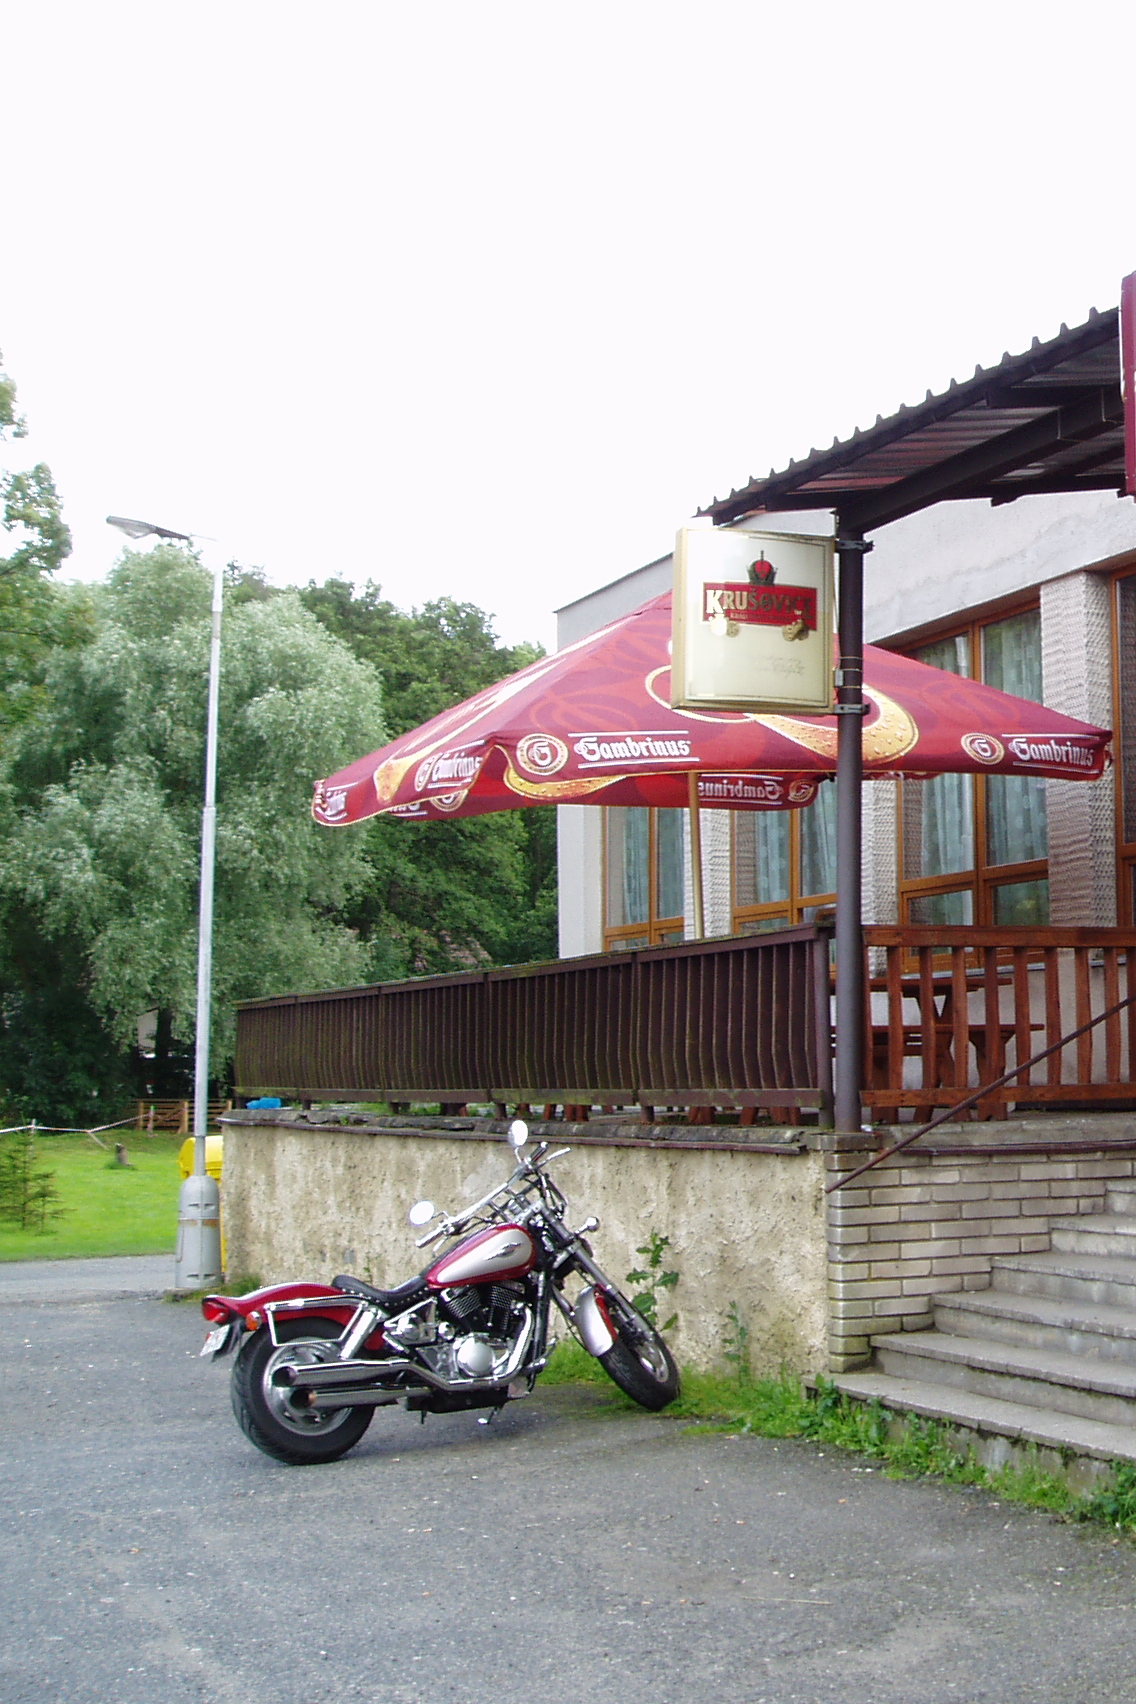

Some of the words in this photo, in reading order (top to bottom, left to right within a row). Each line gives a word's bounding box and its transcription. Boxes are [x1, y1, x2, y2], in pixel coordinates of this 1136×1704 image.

[706, 587, 815, 620] KRUŠOVICE
[574, 736, 691, 761] Gambrinus
[1008, 738, 1095, 767] Gambrinus
